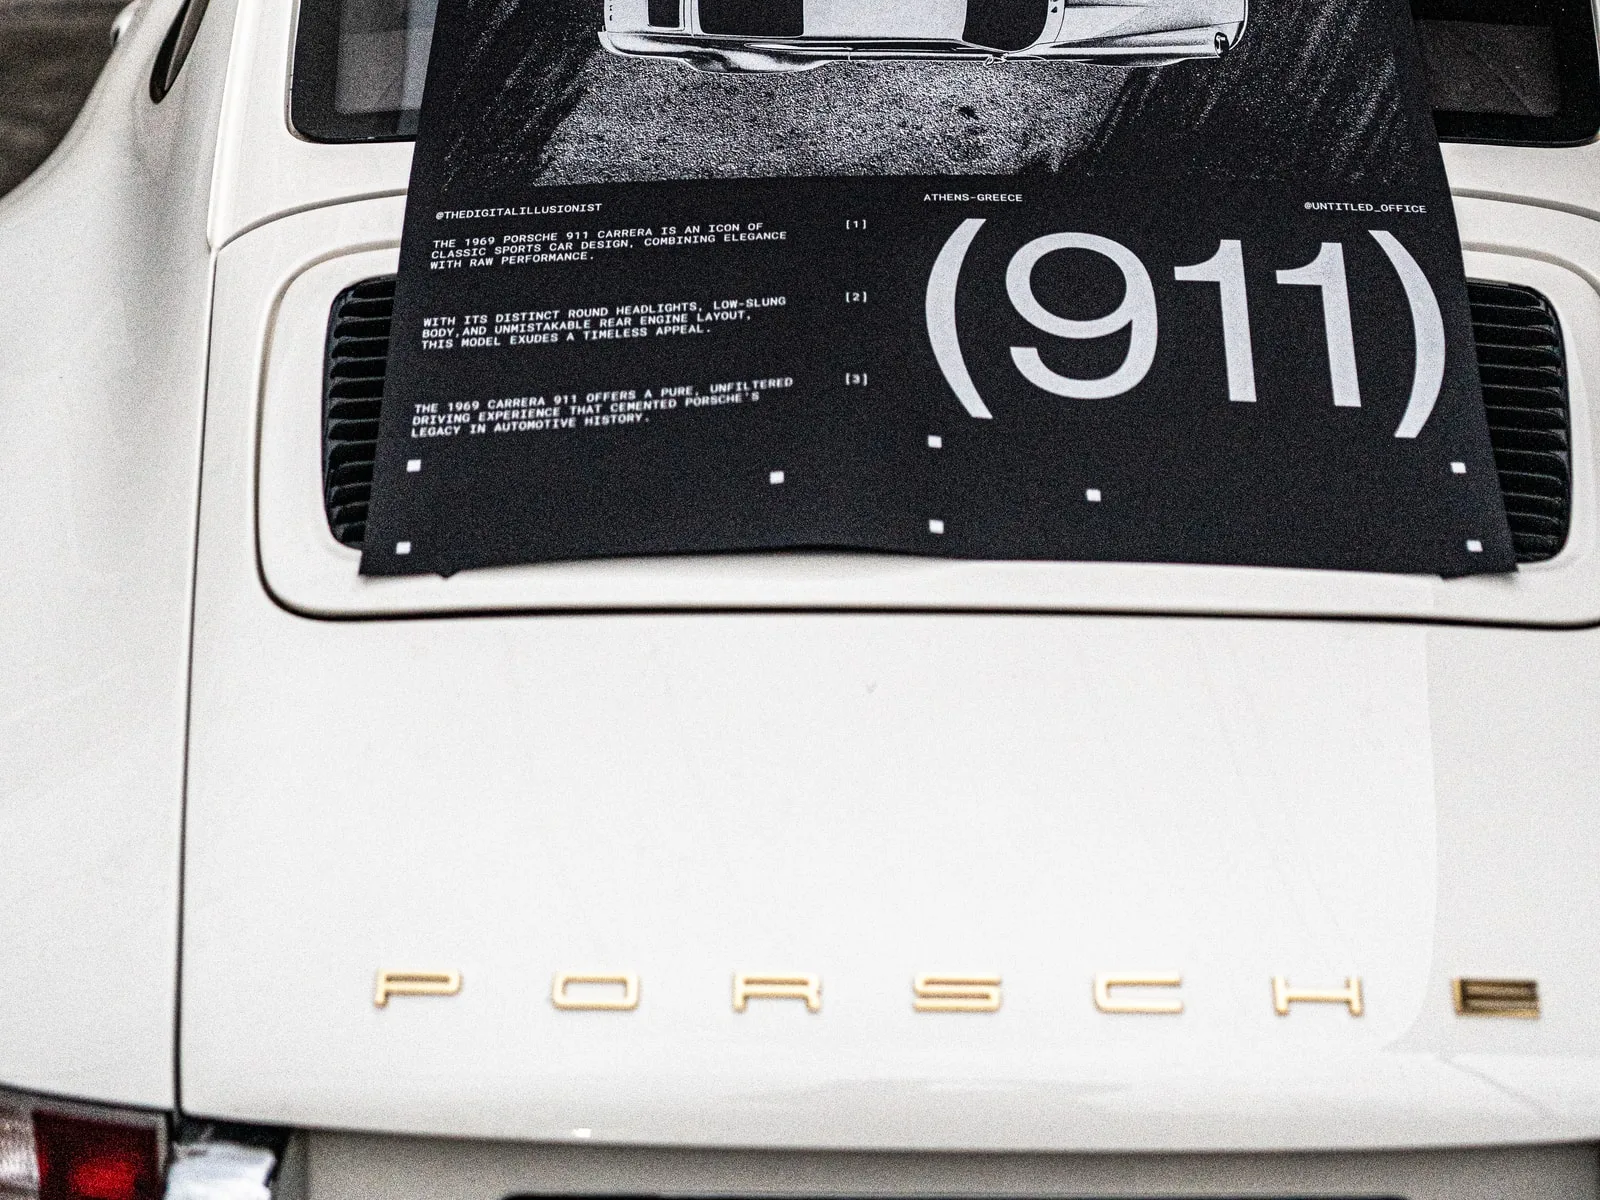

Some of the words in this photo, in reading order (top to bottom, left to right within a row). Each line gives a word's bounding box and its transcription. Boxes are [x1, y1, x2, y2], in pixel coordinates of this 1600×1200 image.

[923, 193, 1023, 202] ATHENS-GREECE
[1303, 201, 1428, 214] @UNTITLED_OFFICE
[435, 203, 603, 221] @THEDIGITALILLUSIONIST
[431, 248, 487, 260] CLASSIC
[494, 244, 542, 255] SPORTS
[550, 242, 573, 252] CAR
[644, 234, 716, 247] COMBINING
[724, 231, 788, 242] ELEGANCE
[433, 239, 457, 249] THE
[464, 236, 496, 247] 1969
[503, 232, 558, 244] PORSCHE
[566, 231, 589, 240] 911
[597, 228, 653, 239] CARRERA
[661, 226, 677, 236] IS
[684, 225, 700, 234] AN
[708, 223, 740, 233] ICON
[747, 222, 764, 231] OF
[430, 260, 462, 270] WITH
[469, 257, 494, 267] RAW
[501, 252, 594, 265] PERFORMANCE.
[423, 316, 456, 327] WITH
[464, 314, 488, 325] ITS
[496, 310, 560, 323] DISTINCT
[568, 307, 608, 319] ROUND
[713, 296, 787, 311] LOW-SLUNG
[494, 319, 591, 334] UNMISTAKABLE
[600, 317, 632, 328] REAR
[640, 313, 689, 325] ENGINE
[697, 310, 751, 322] LAYOUT,
[422, 339, 454, 350] THIS
[461, 336, 501, 347] MODEL
[510, 333, 559, 345] EXUDES
[566, 332, 575, 341] A
[583, 326, 648, 340] TIMELESS
[656, 324, 711, 336] APPEAL.
[412, 413, 470, 426] DRIVING
[478, 406, 561, 422] EXPERIENCE
[569, 403, 603, 416] THAT
[610, 398, 677, 413] CEMENTED
[685, 391, 760, 407] PORSCHE'S
[414, 403, 439, 414] THE
[448, 400, 480, 412] 1969
[487, 396, 546, 409] CARRERA
[553, 394, 577, 405] 911
[586, 390, 636, 403] OFFERS
[644, 388, 652, 398] A
[710, 377, 794, 394] UNFILTERED
[411, 425, 461, 439] LEGACY
[470, 423, 486, 435] IN
[494, 417, 576, 432] AUTOMOTIVE
[584, 412, 650, 427] HISTORY.
[373, 967, 1541, 1019] PORSCHE
